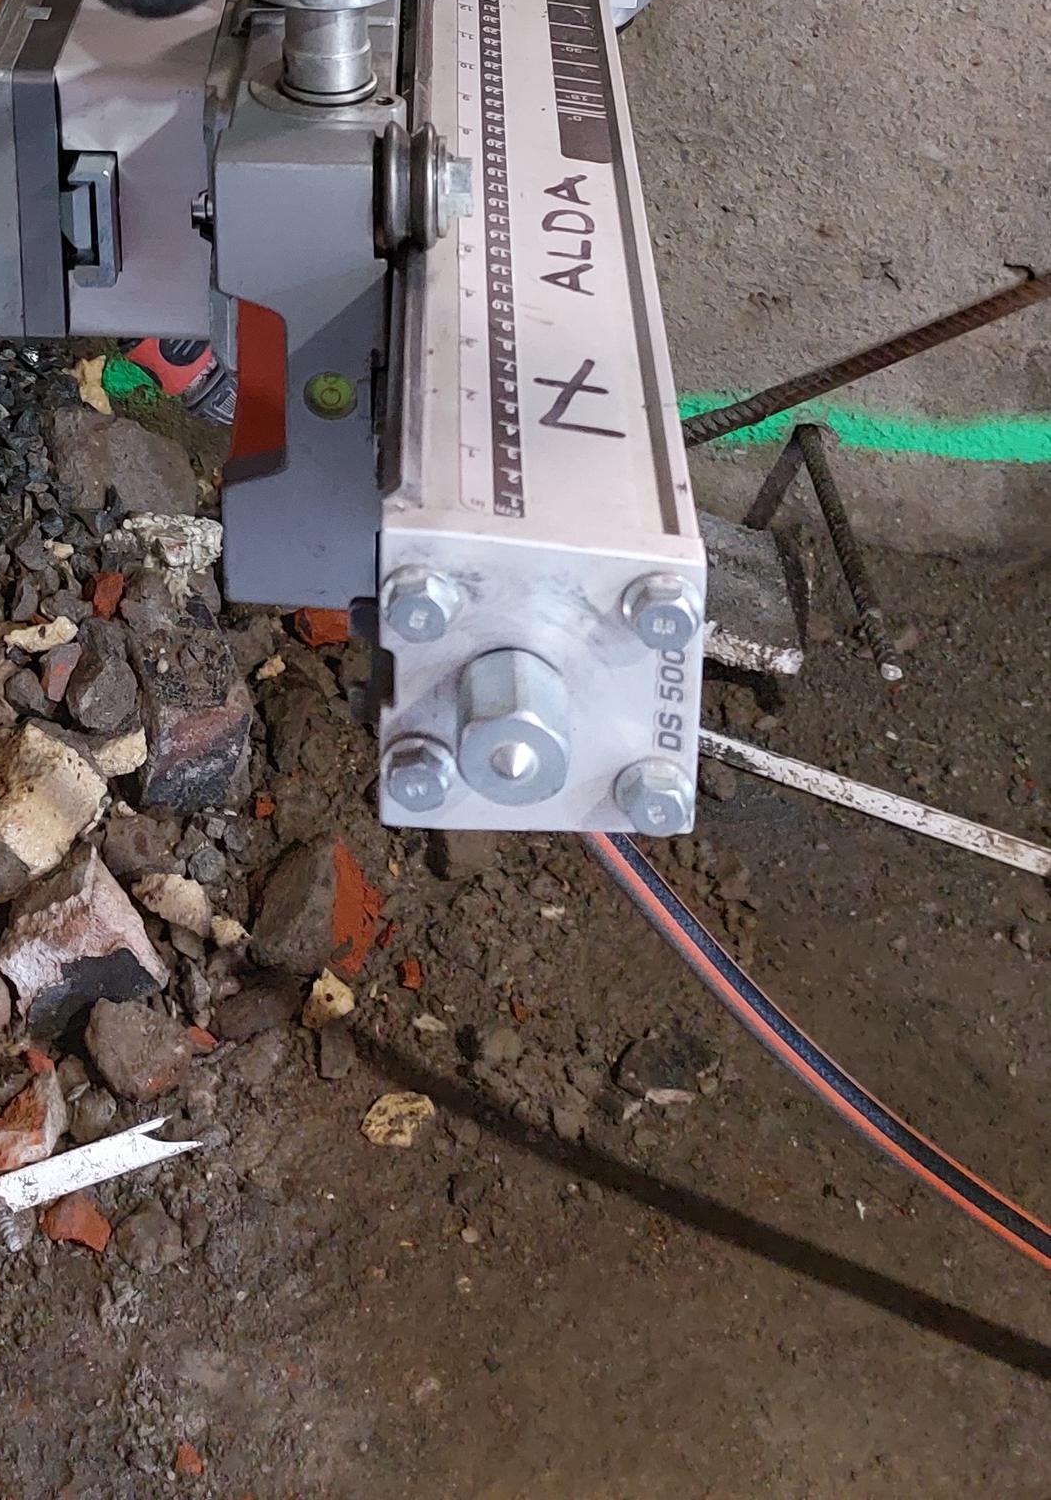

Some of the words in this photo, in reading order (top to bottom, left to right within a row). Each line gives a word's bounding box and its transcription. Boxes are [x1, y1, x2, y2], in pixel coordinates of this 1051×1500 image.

[541, 174, 595, 295] ALDA
[660, 650, 686, 703] 500
[657, 712, 683, 752] DS
